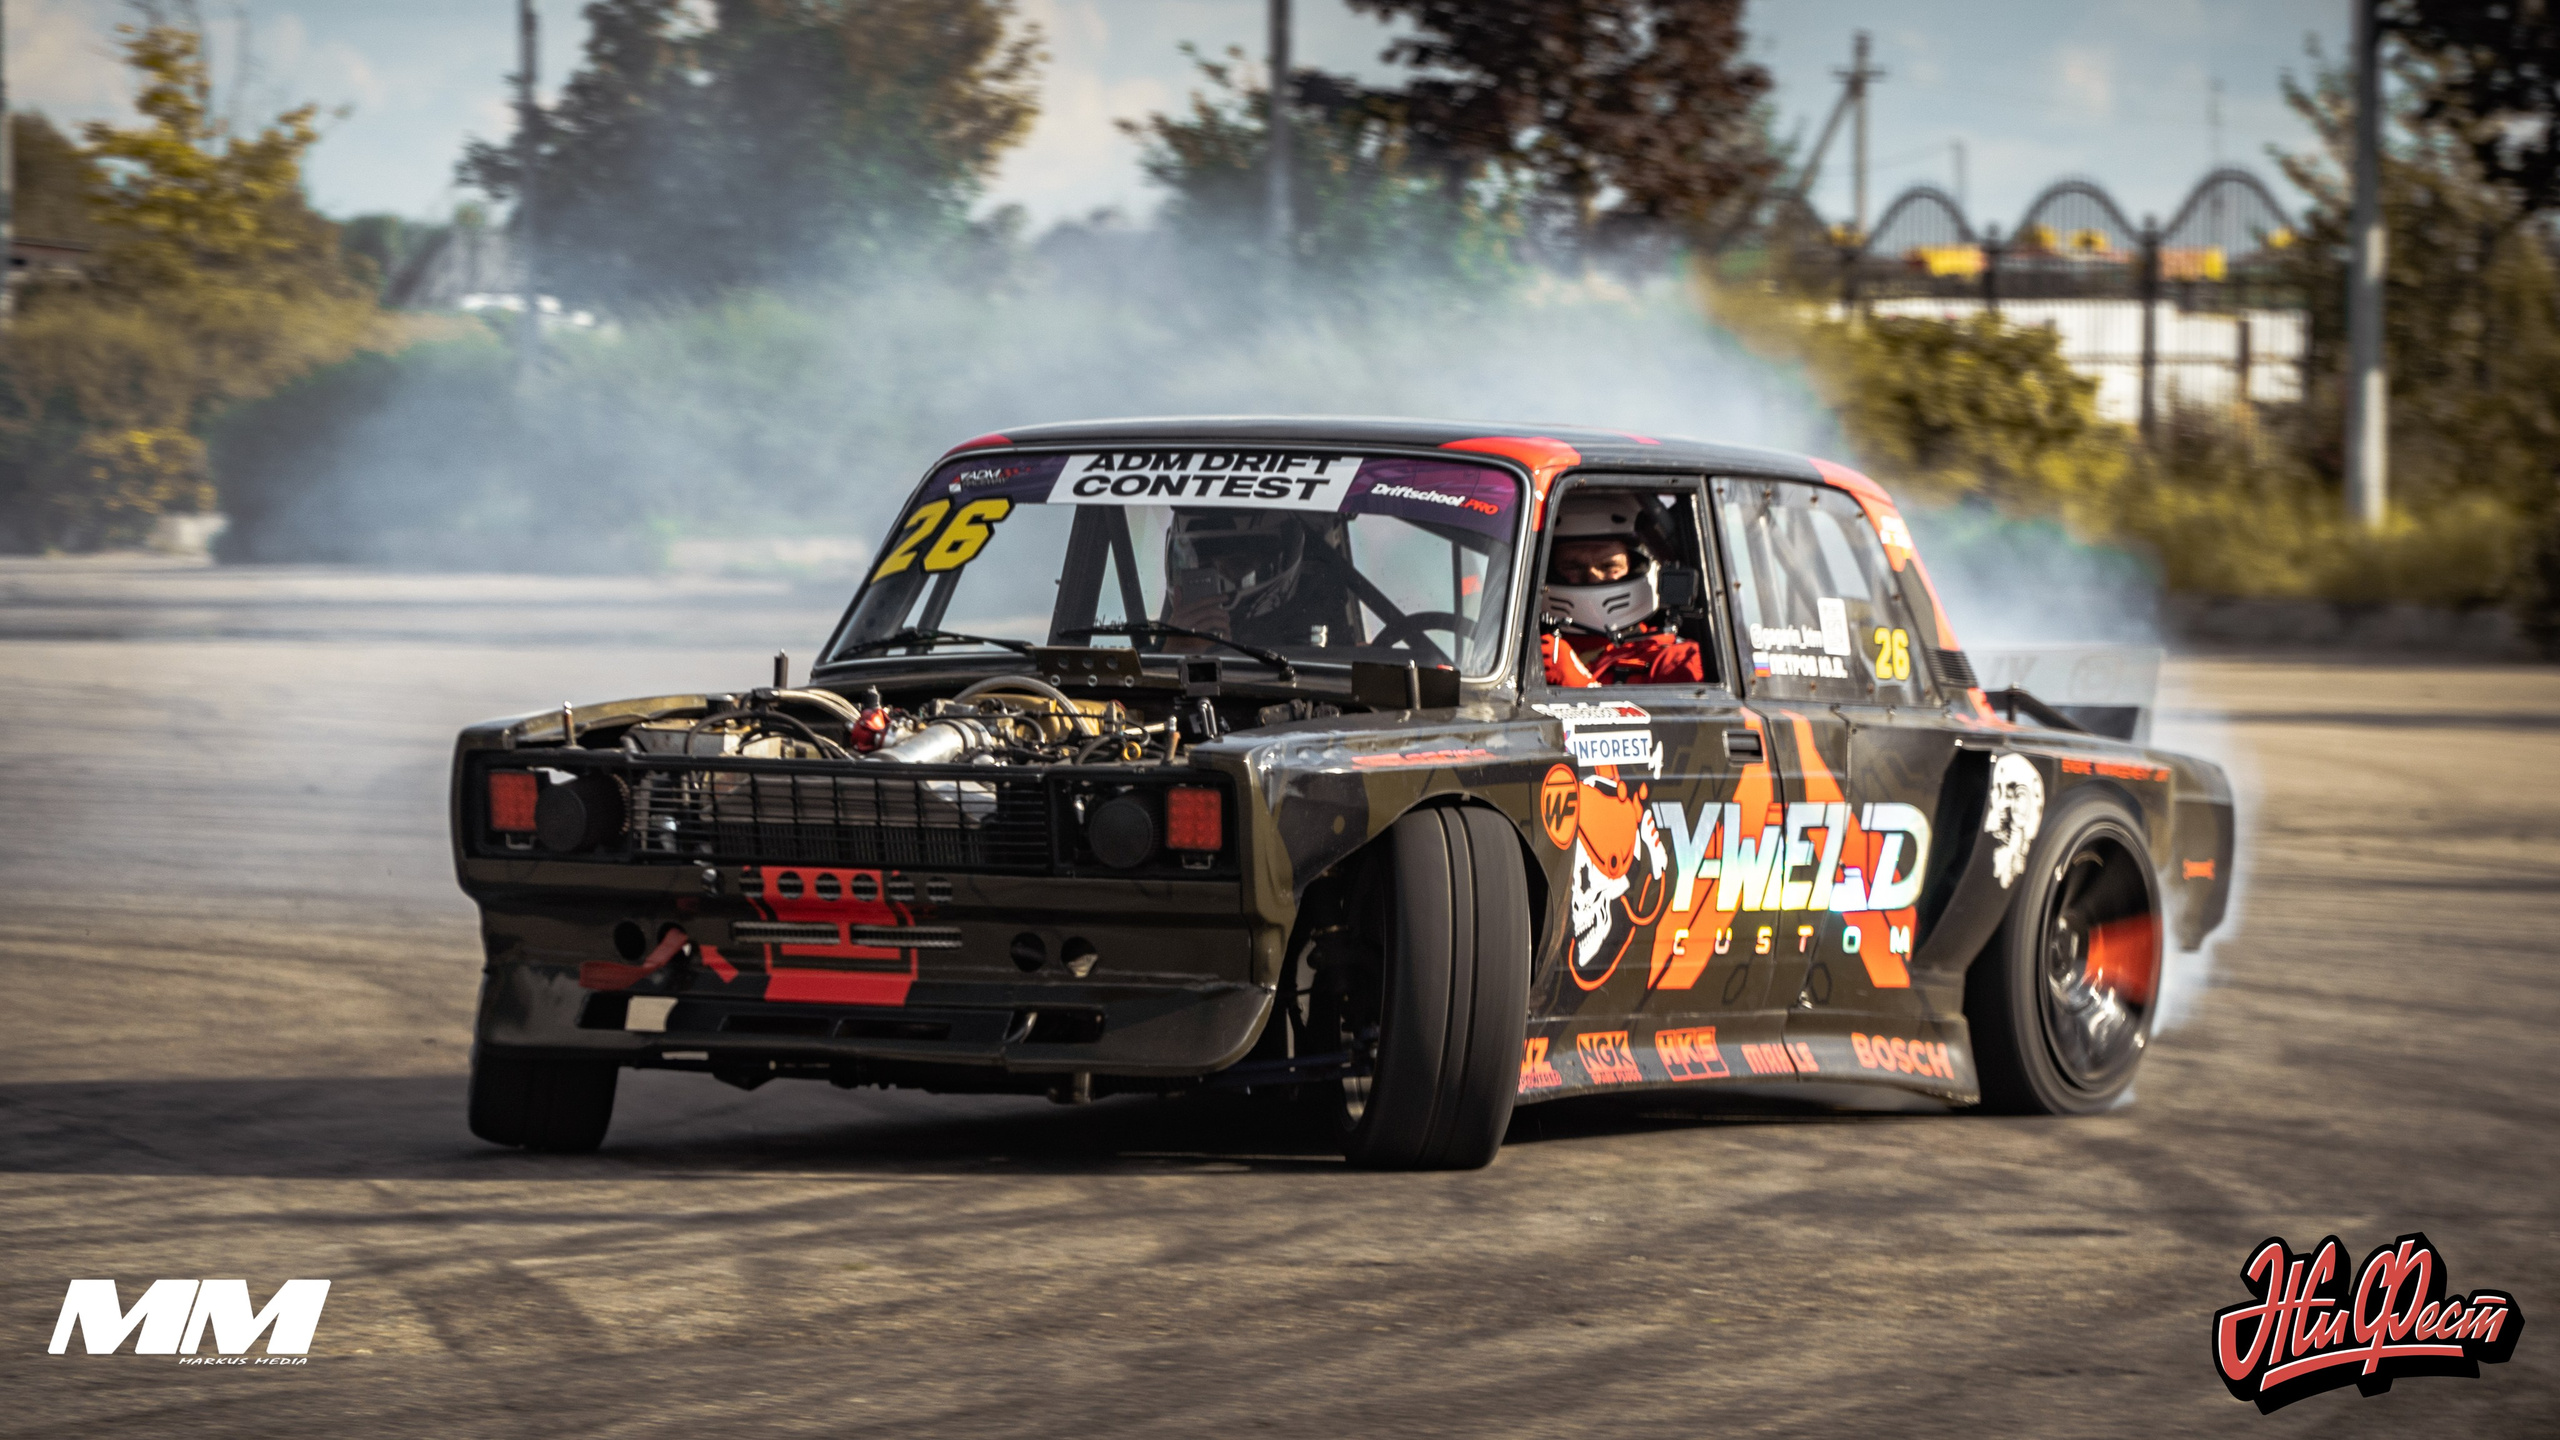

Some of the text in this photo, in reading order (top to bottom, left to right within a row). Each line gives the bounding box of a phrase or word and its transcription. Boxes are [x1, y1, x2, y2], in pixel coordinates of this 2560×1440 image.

[1083, 451, 1342, 475] ADM DRIFT
[1072, 474, 1331, 501] CONTEST
[869, 498, 1010, 583] 26
[1874, 627, 1910, 681] 26
[1672, 924, 1911, 956] CUSTOM
[1578, 1034, 1635, 1070] NGK
[1850, 1031, 1955, 1080] BOSCH
